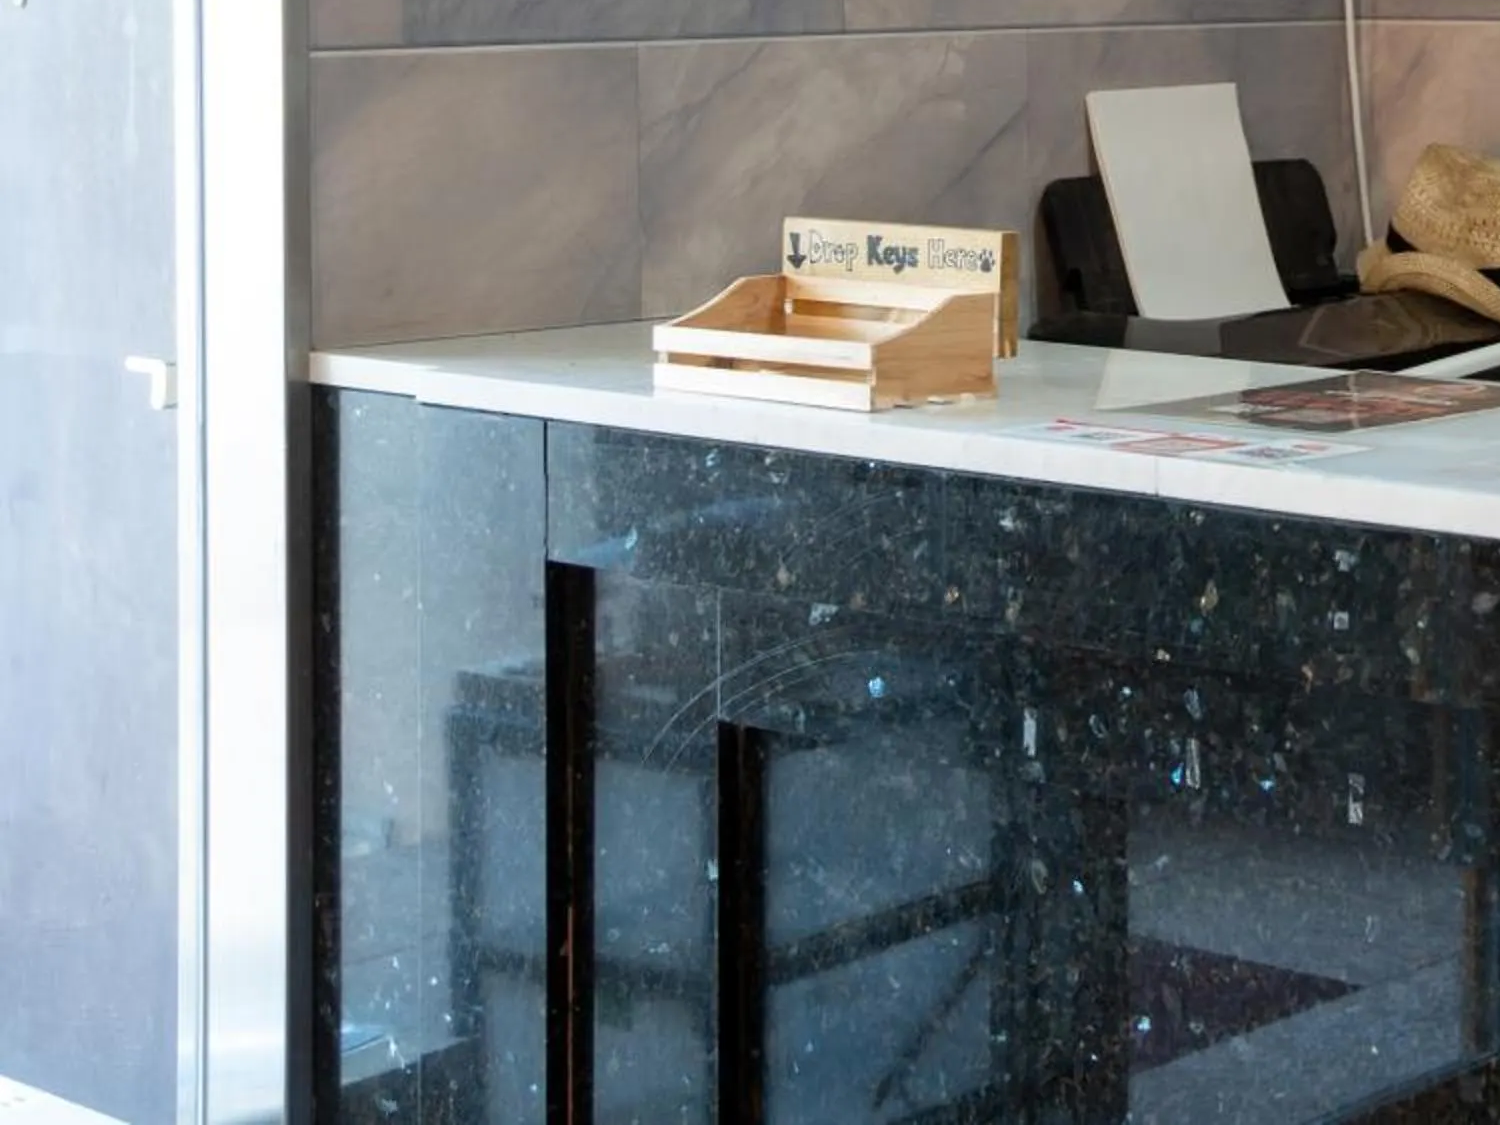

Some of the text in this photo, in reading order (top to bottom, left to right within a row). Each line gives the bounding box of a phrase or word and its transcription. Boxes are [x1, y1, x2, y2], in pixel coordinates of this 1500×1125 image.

[808, 229, 980, 274] Drop Keys Here
